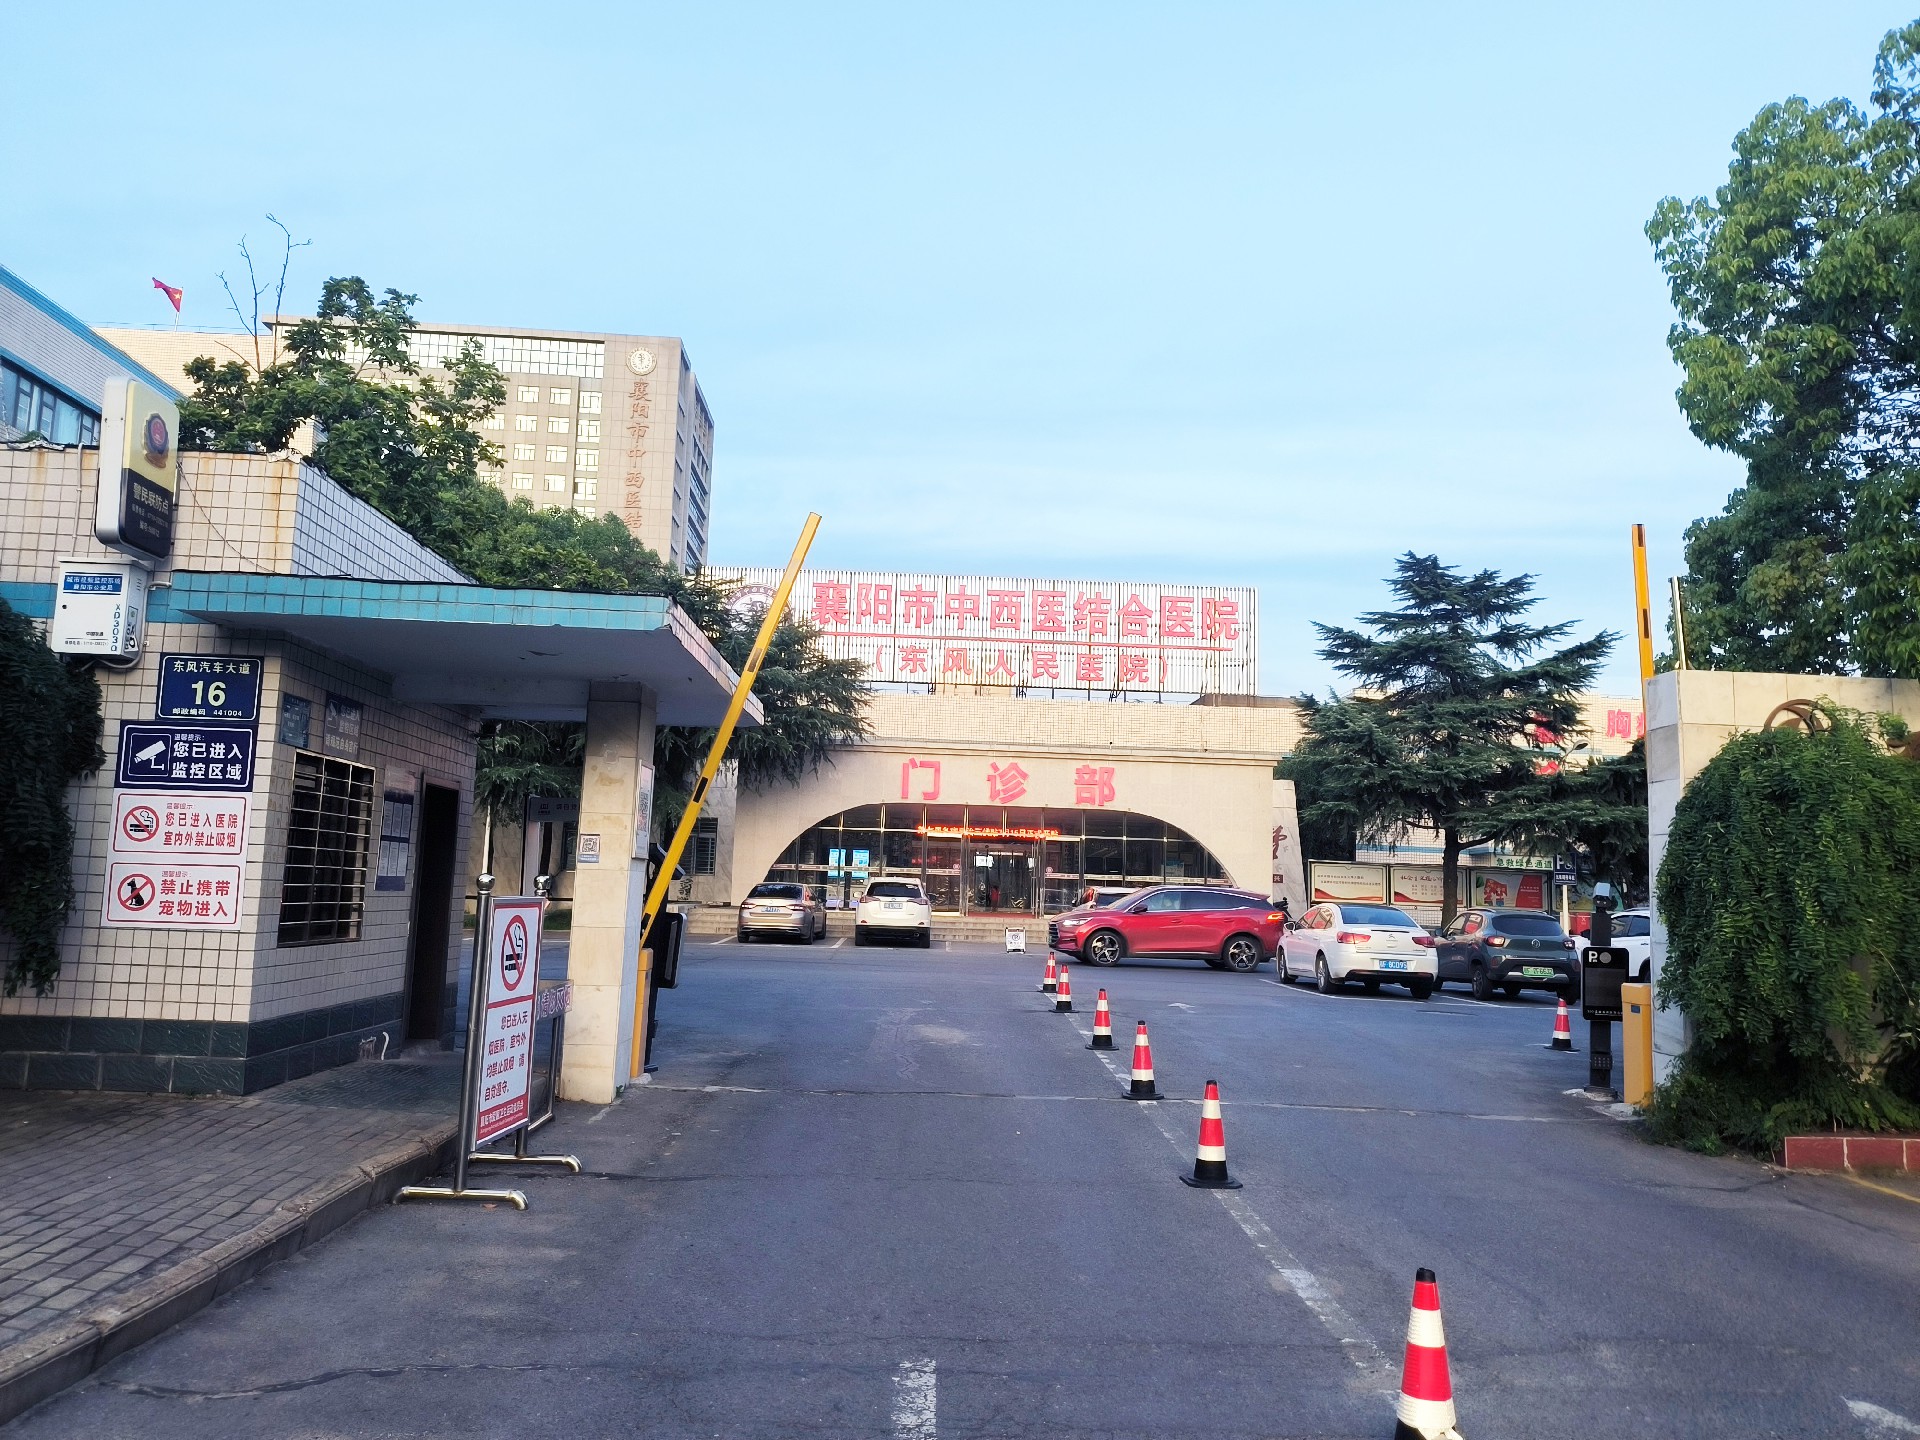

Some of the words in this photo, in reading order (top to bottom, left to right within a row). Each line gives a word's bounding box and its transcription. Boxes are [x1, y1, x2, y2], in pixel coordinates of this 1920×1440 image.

[811, 580, 1239, 640] 襄阳市中西医结合医院
[173, 660, 250, 674] 东风汽车大道
[875, 645, 1168, 684] （东风人民医院）
[191, 680, 226, 706] 16
[172, 707, 206, 716] 邮政编码
[213, 709, 242, 717] 441004
[173, 741, 243, 760] 您已进入
[171, 761, 243, 780] 监控区域
[901, 757, 1115, 806] 门诊部
[165, 812, 238, 829] 您已进入医院
[163, 831, 236, 848] 室内外禁止吸烟
[1496, 858, 1552, 869] 急救绿色通道
[160, 879, 231, 897] 禁止携带
[159, 900, 228, 917] 宠物进入
